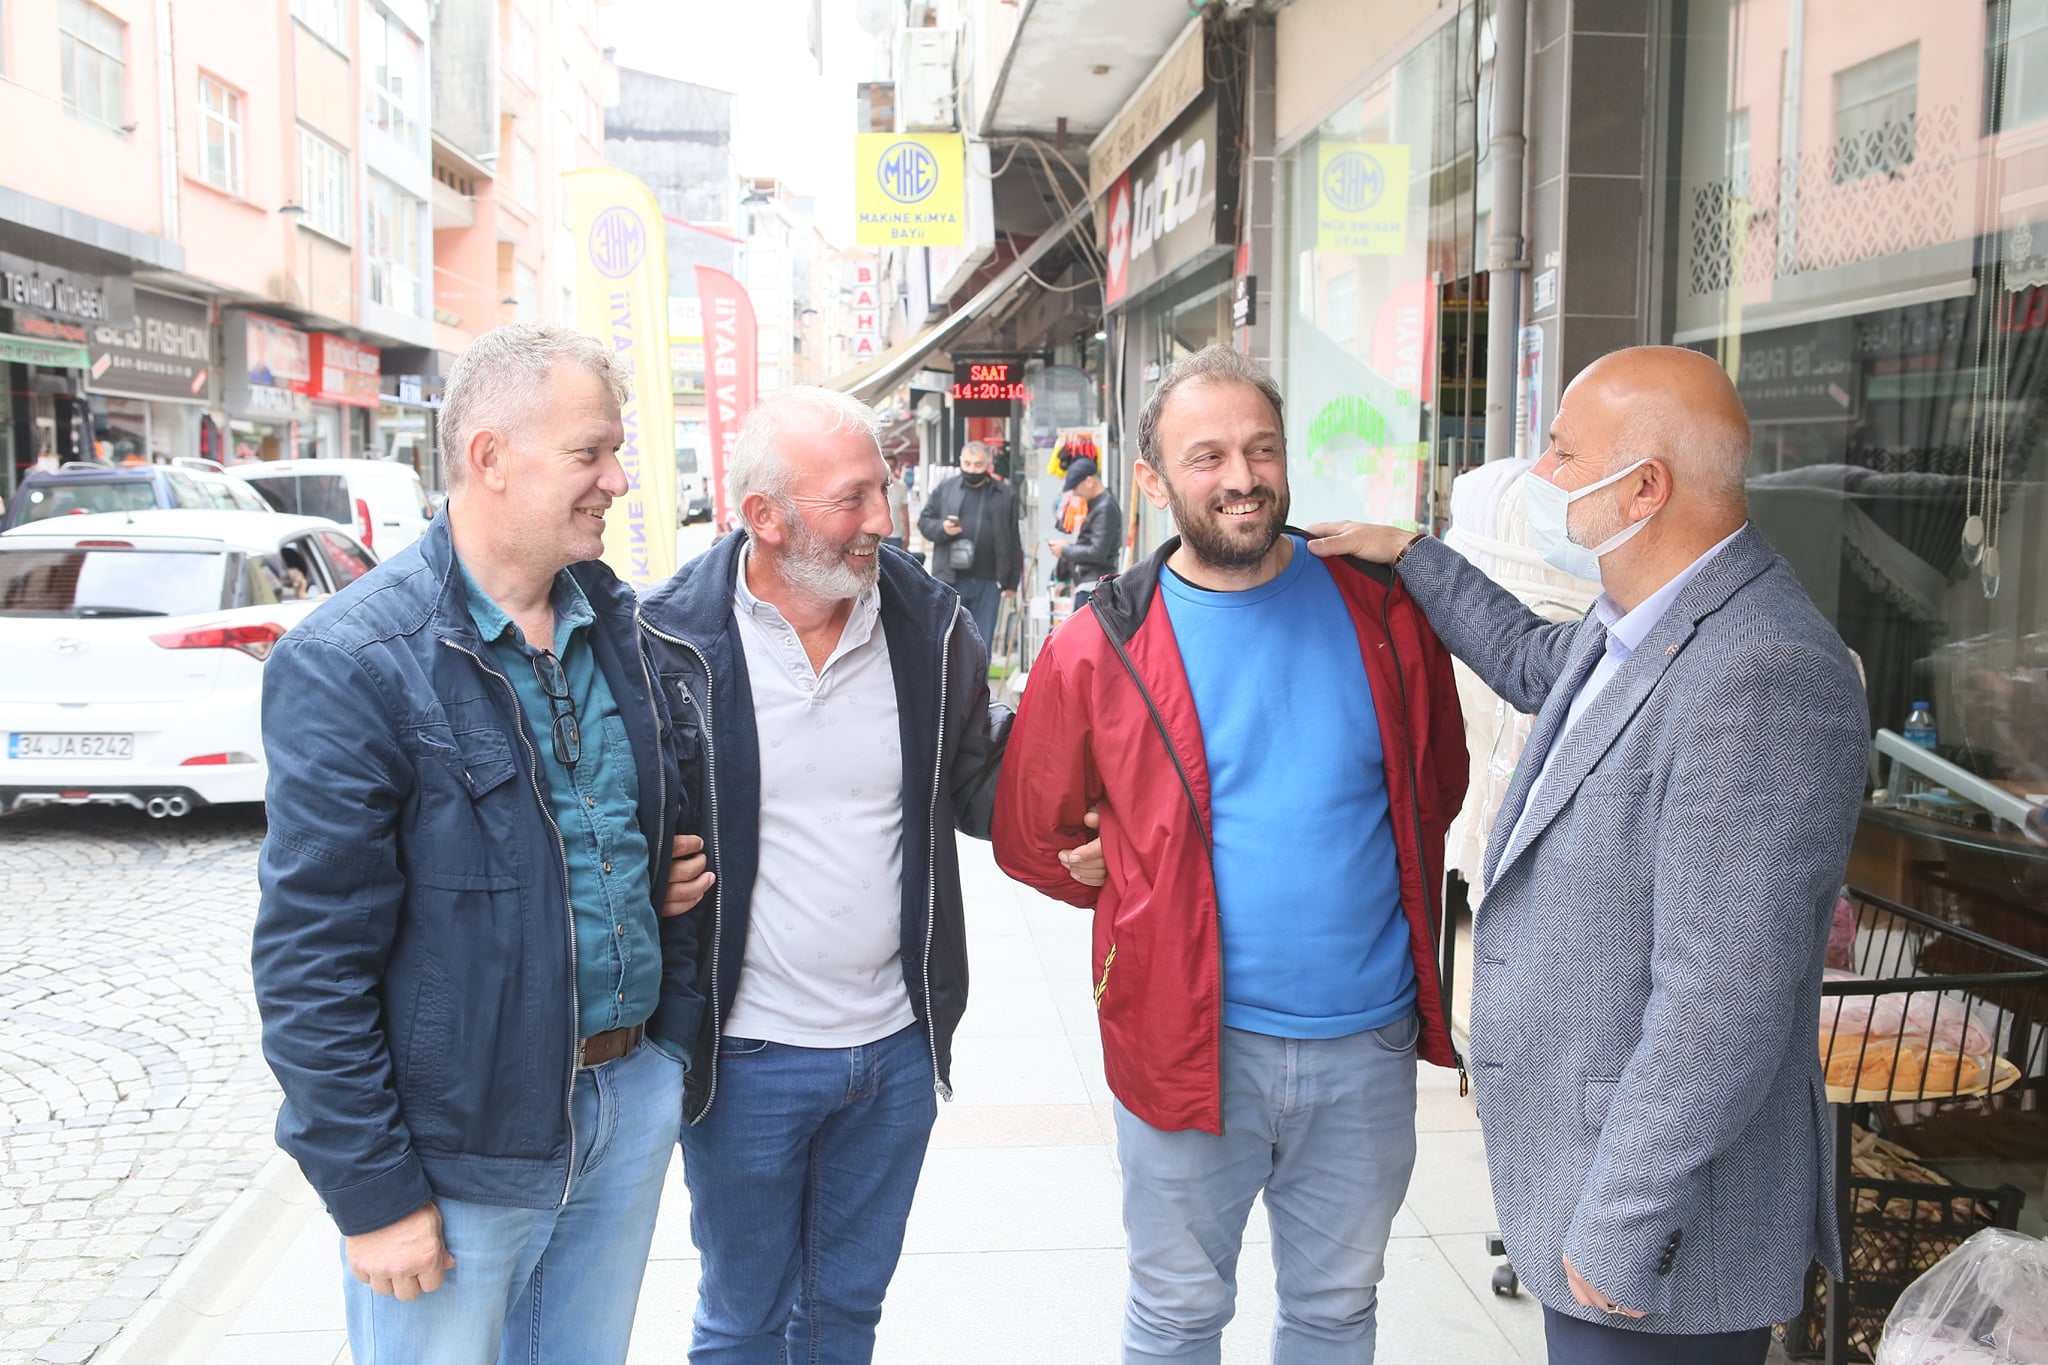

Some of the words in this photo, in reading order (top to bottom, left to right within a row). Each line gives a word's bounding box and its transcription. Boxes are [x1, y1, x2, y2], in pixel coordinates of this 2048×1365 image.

[884, 148, 932, 197] MKE
[1131, 138, 1206, 260] lotto
[970, 365, 1009, 381] SAAT
[21, 736, 43, 756] 34
[47, 736, 77, 756] JA
[81, 736, 130, 756] 6242
